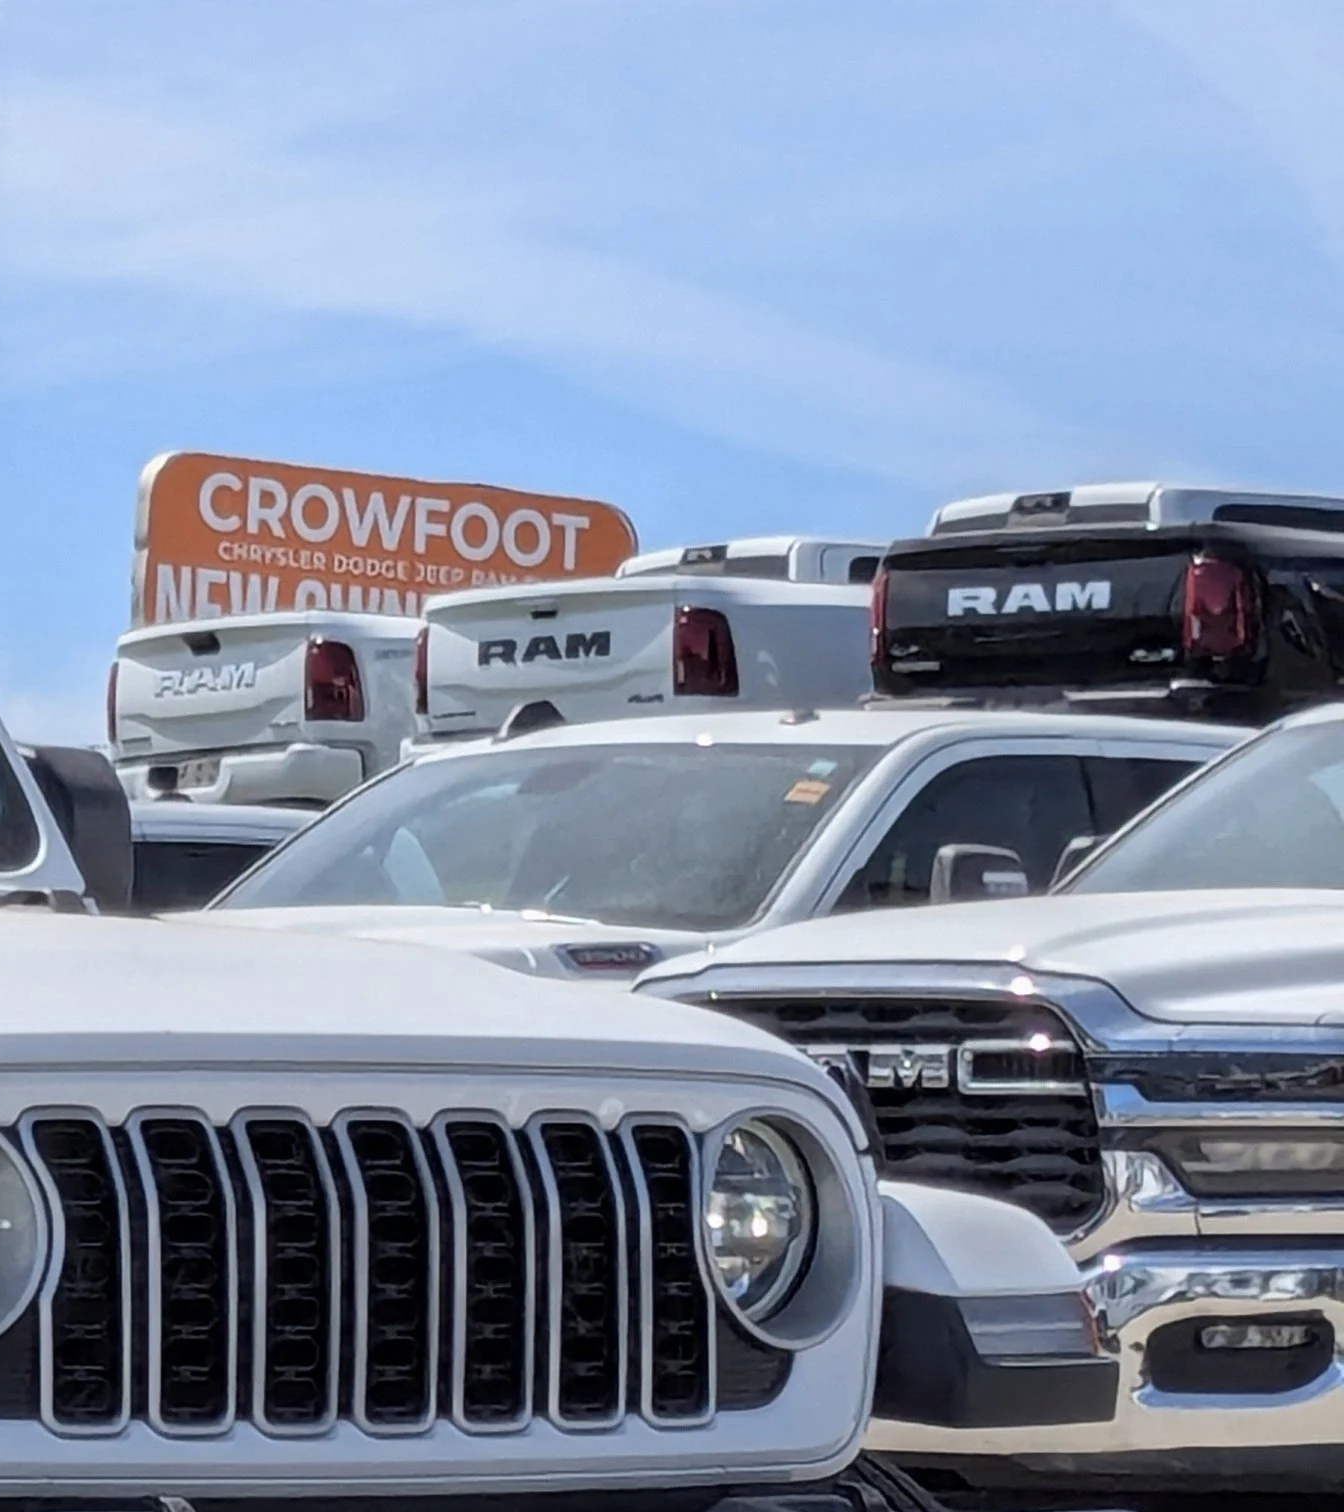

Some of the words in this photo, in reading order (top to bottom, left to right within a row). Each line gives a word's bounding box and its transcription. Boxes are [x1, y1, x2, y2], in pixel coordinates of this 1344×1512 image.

[198, 472, 590, 570] CROWFOOT
[218, 541, 326, 571] CHRYSLER
[333, 554, 408, 580] DODGE
[414, 561, 465, 585] JEEP
[154, 563, 280, 625] NEW
[947, 580, 1111, 617] RAM
[478, 630, 611, 667] RAM
[154, 660, 257, 698] RAM
